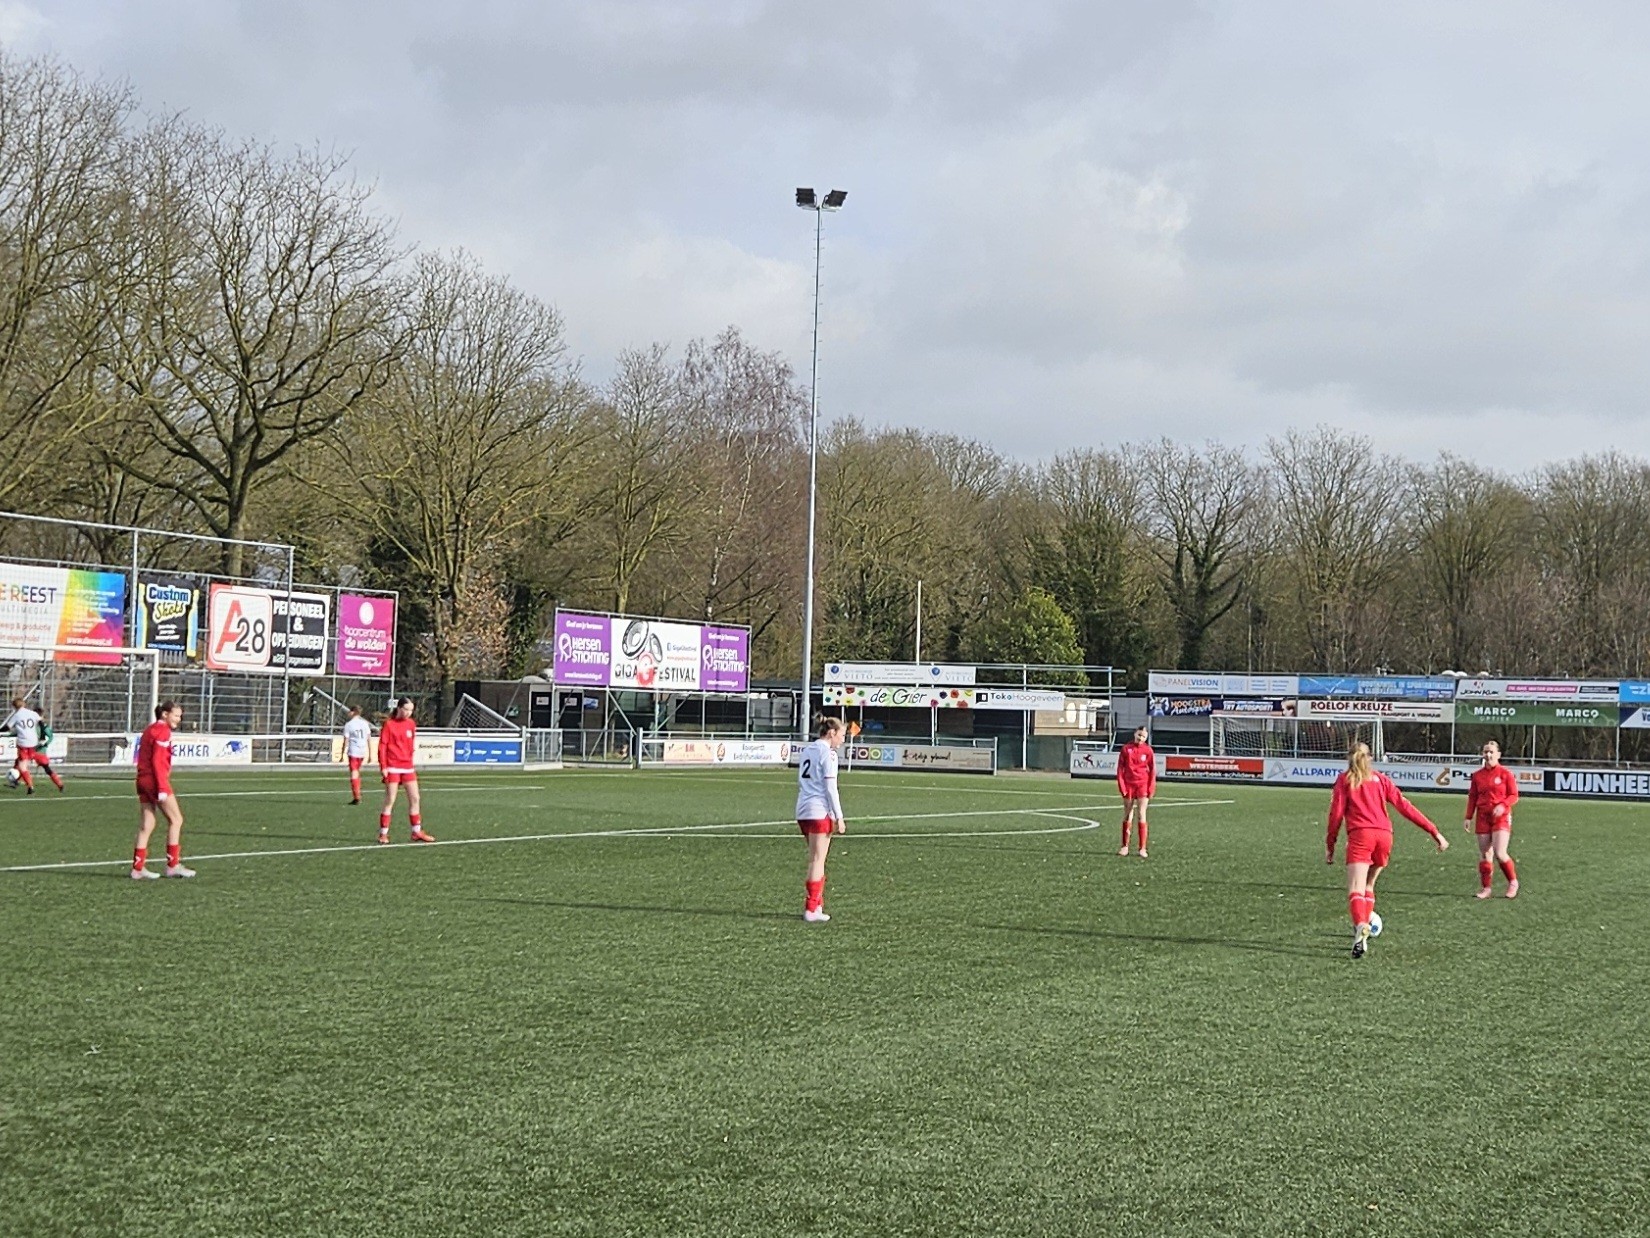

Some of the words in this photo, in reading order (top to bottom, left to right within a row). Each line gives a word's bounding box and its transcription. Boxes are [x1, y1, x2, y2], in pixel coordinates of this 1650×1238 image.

[10, 584, 57, 604] REEST
[148, 586, 189, 602] Custom
[0, 604, 49, 614] ULTIMEDIA
[154, 600, 184, 620] Shots
[214, 599, 266, 654] A28
[292, 616, 305, 631] &
[344, 637, 357, 649] de
[356, 639, 387, 651] wolden
[572, 636, 602, 652] Hersen
[571, 650, 610, 665] STICHTING
[713, 647, 738, 661] Hersen
[712, 659, 746, 674] STICHTING
[870, 688, 888, 704] de
[891, 688, 928, 705] Gier
[1310, 701, 1351, 712] ROELOF
[1352, 702, 1394, 712] KREUZE
[1474, 706, 1517, 717] MARCO
[1555, 708, 1600, 719] MARCO
[20, 718, 35, 729] 10
[801, 759, 812, 779] 2
[1189, 762, 1240, 771] WESTERBEEK
[1292, 766, 1343, 777] ALLPARTS
[1451, 769, 1473, 781] Py
[1555, 772, 1650, 794] MIJNHEE
